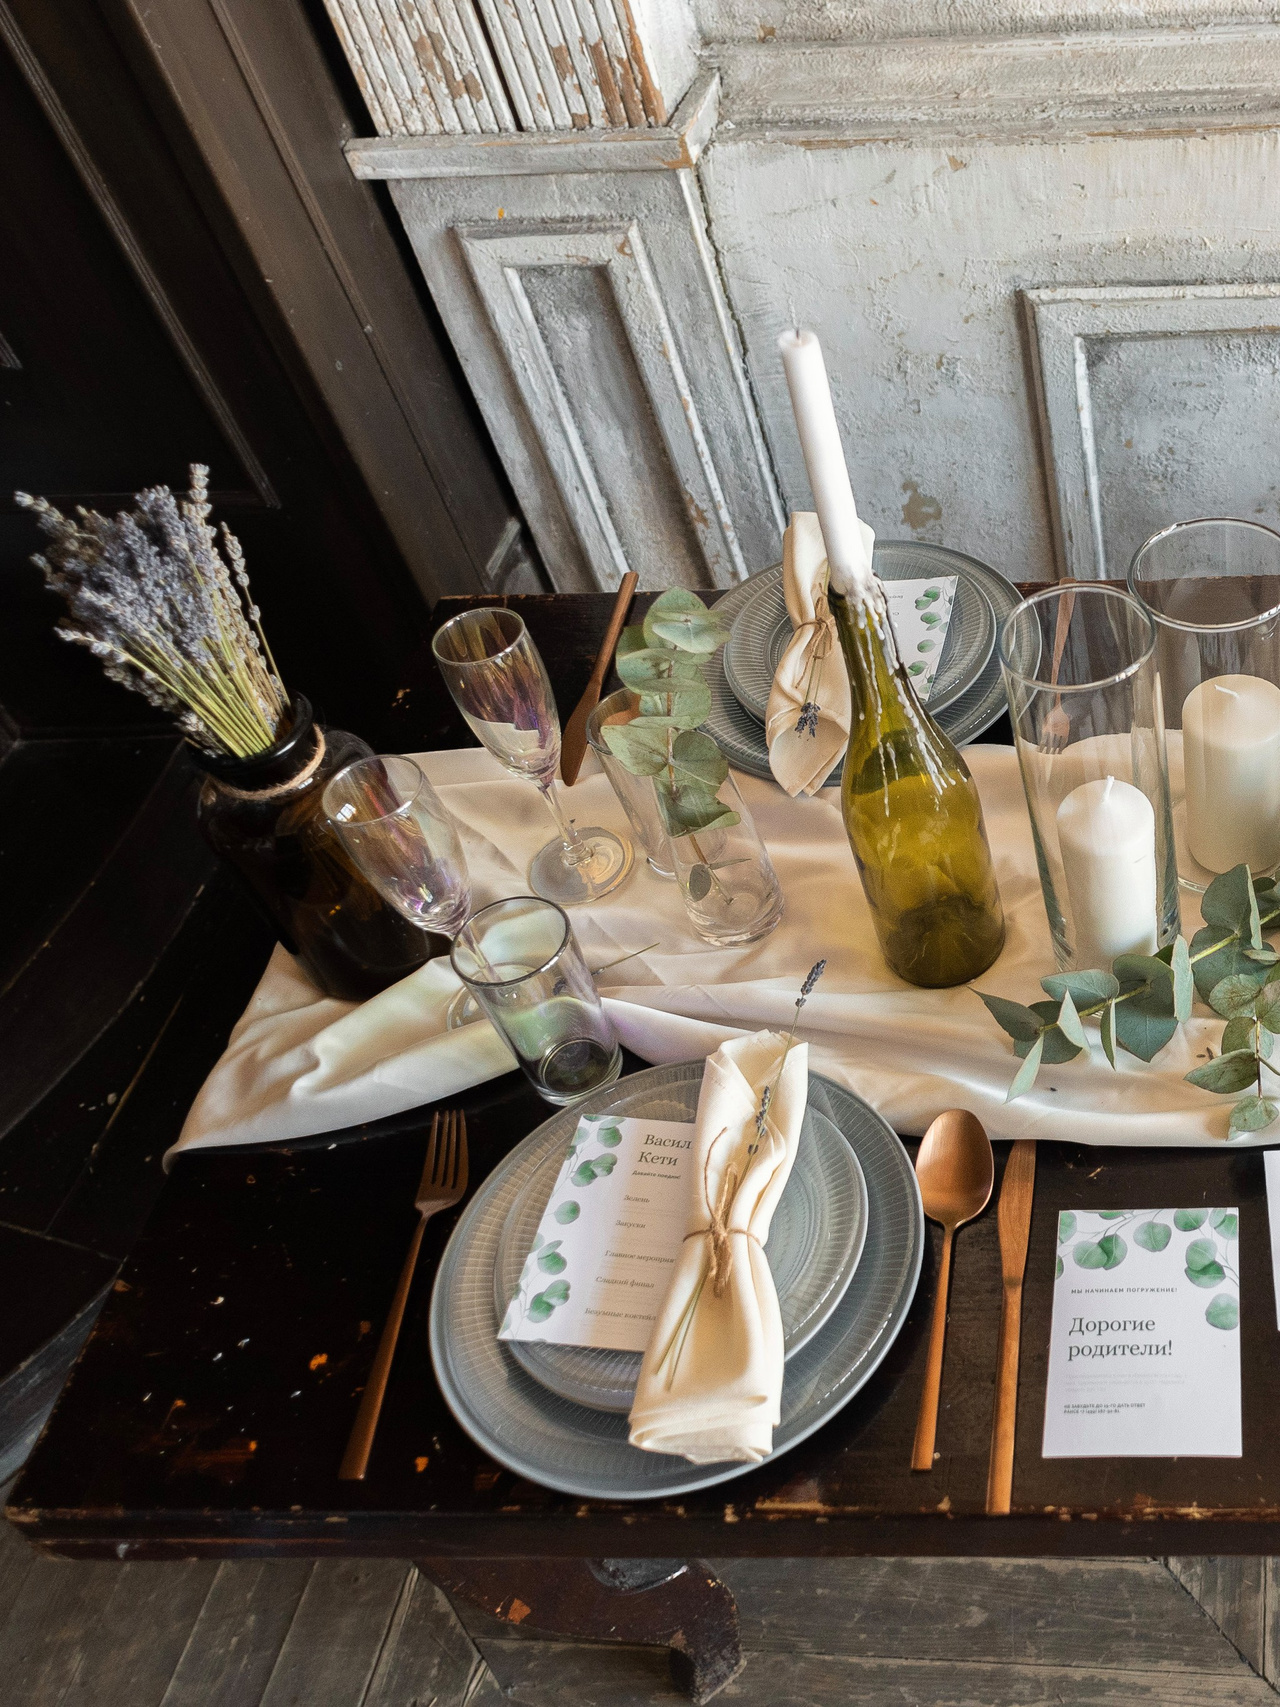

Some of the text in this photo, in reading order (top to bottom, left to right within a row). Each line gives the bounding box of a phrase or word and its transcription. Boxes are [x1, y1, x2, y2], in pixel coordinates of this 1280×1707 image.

[644, 1134, 694, 1150] Васил
[637, 1151, 679, 1166] Кети
[615, 1219, 646, 1229] Закуски
[636, 1254, 676, 1264] мероприя
[624, 1312, 657, 1321] коктейл
[1068, 1317, 1156, 1336] Дорогие
[1068, 1340, 1173, 1362] родители!
